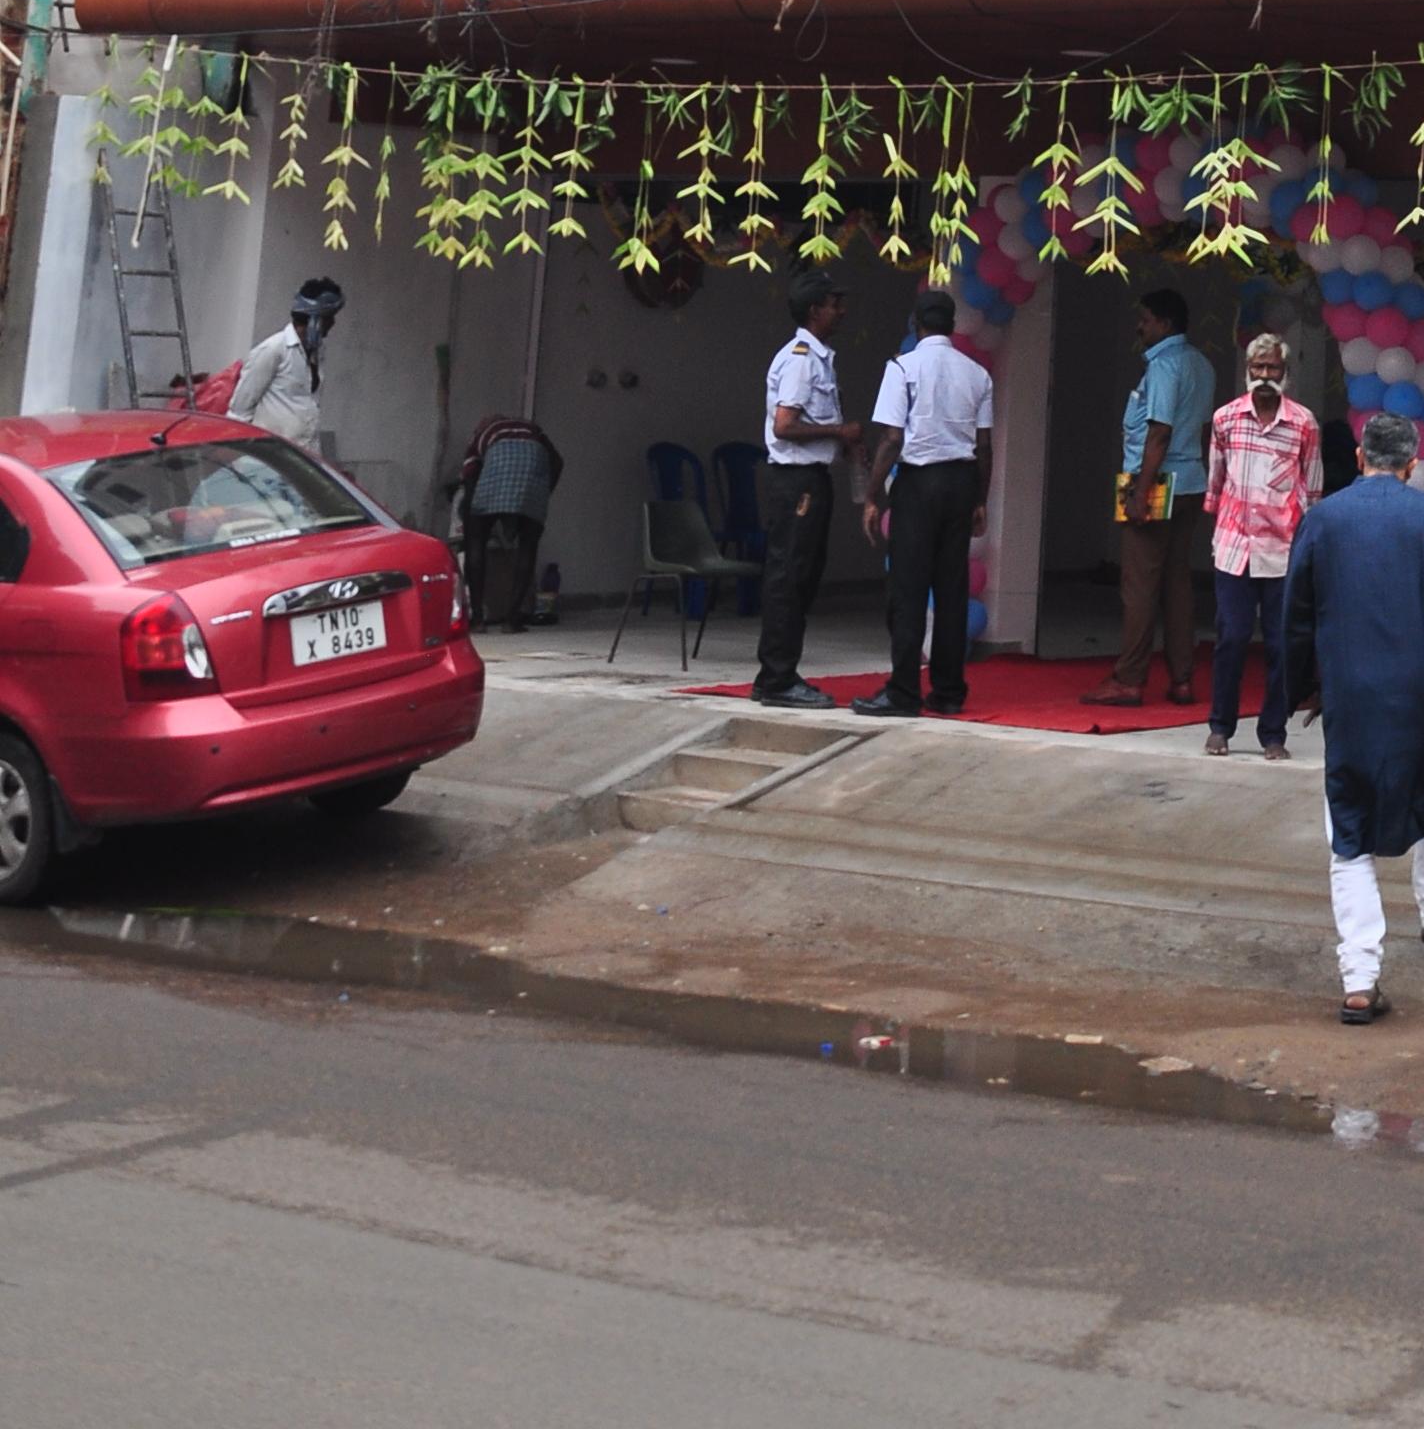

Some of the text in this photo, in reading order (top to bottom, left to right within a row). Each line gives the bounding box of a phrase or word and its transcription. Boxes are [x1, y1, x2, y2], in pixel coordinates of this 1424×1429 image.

[318, 607, 359, 634] TN10
[307, 627, 375, 660] X 8439
